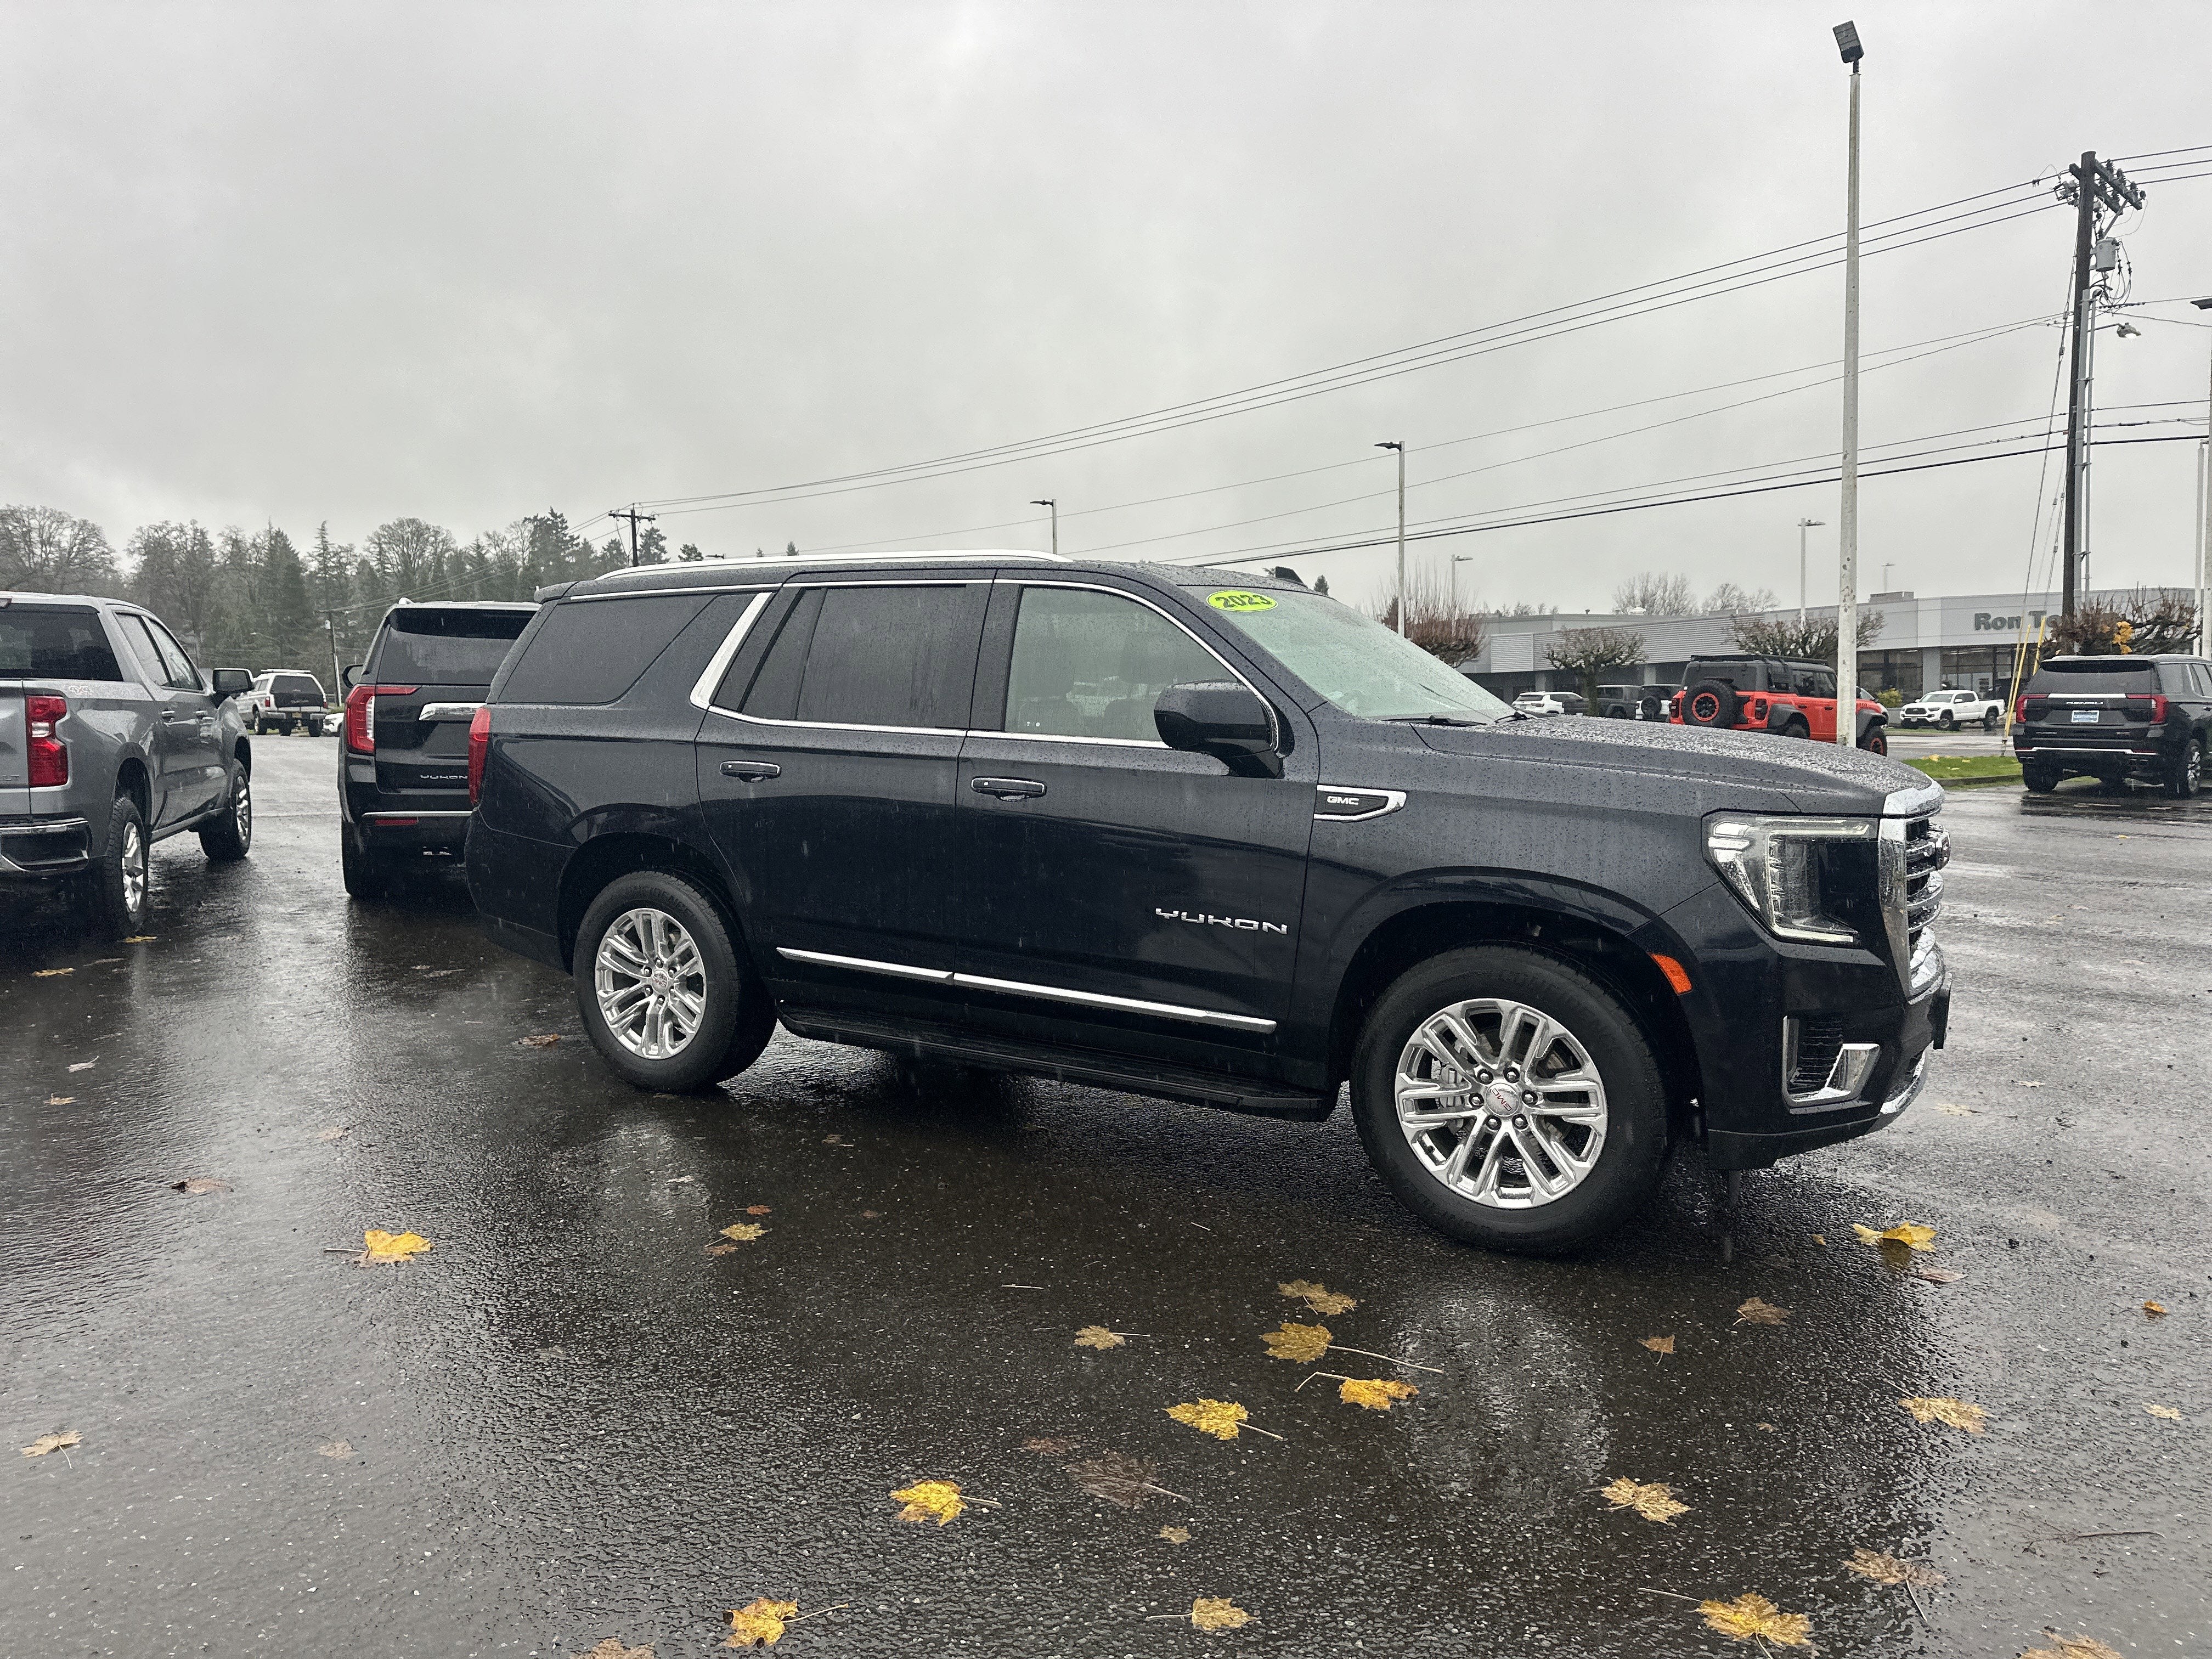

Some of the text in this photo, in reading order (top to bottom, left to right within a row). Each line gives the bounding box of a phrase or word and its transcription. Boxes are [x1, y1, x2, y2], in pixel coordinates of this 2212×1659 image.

[1215, 595, 1272, 608] 2023
[1975, 613, 2021, 630] Ron
[1327, 796, 1359, 805] GMC
[1155, 908, 1288, 935] YUKON
[1492, 1088, 1512, 1111] GMC
